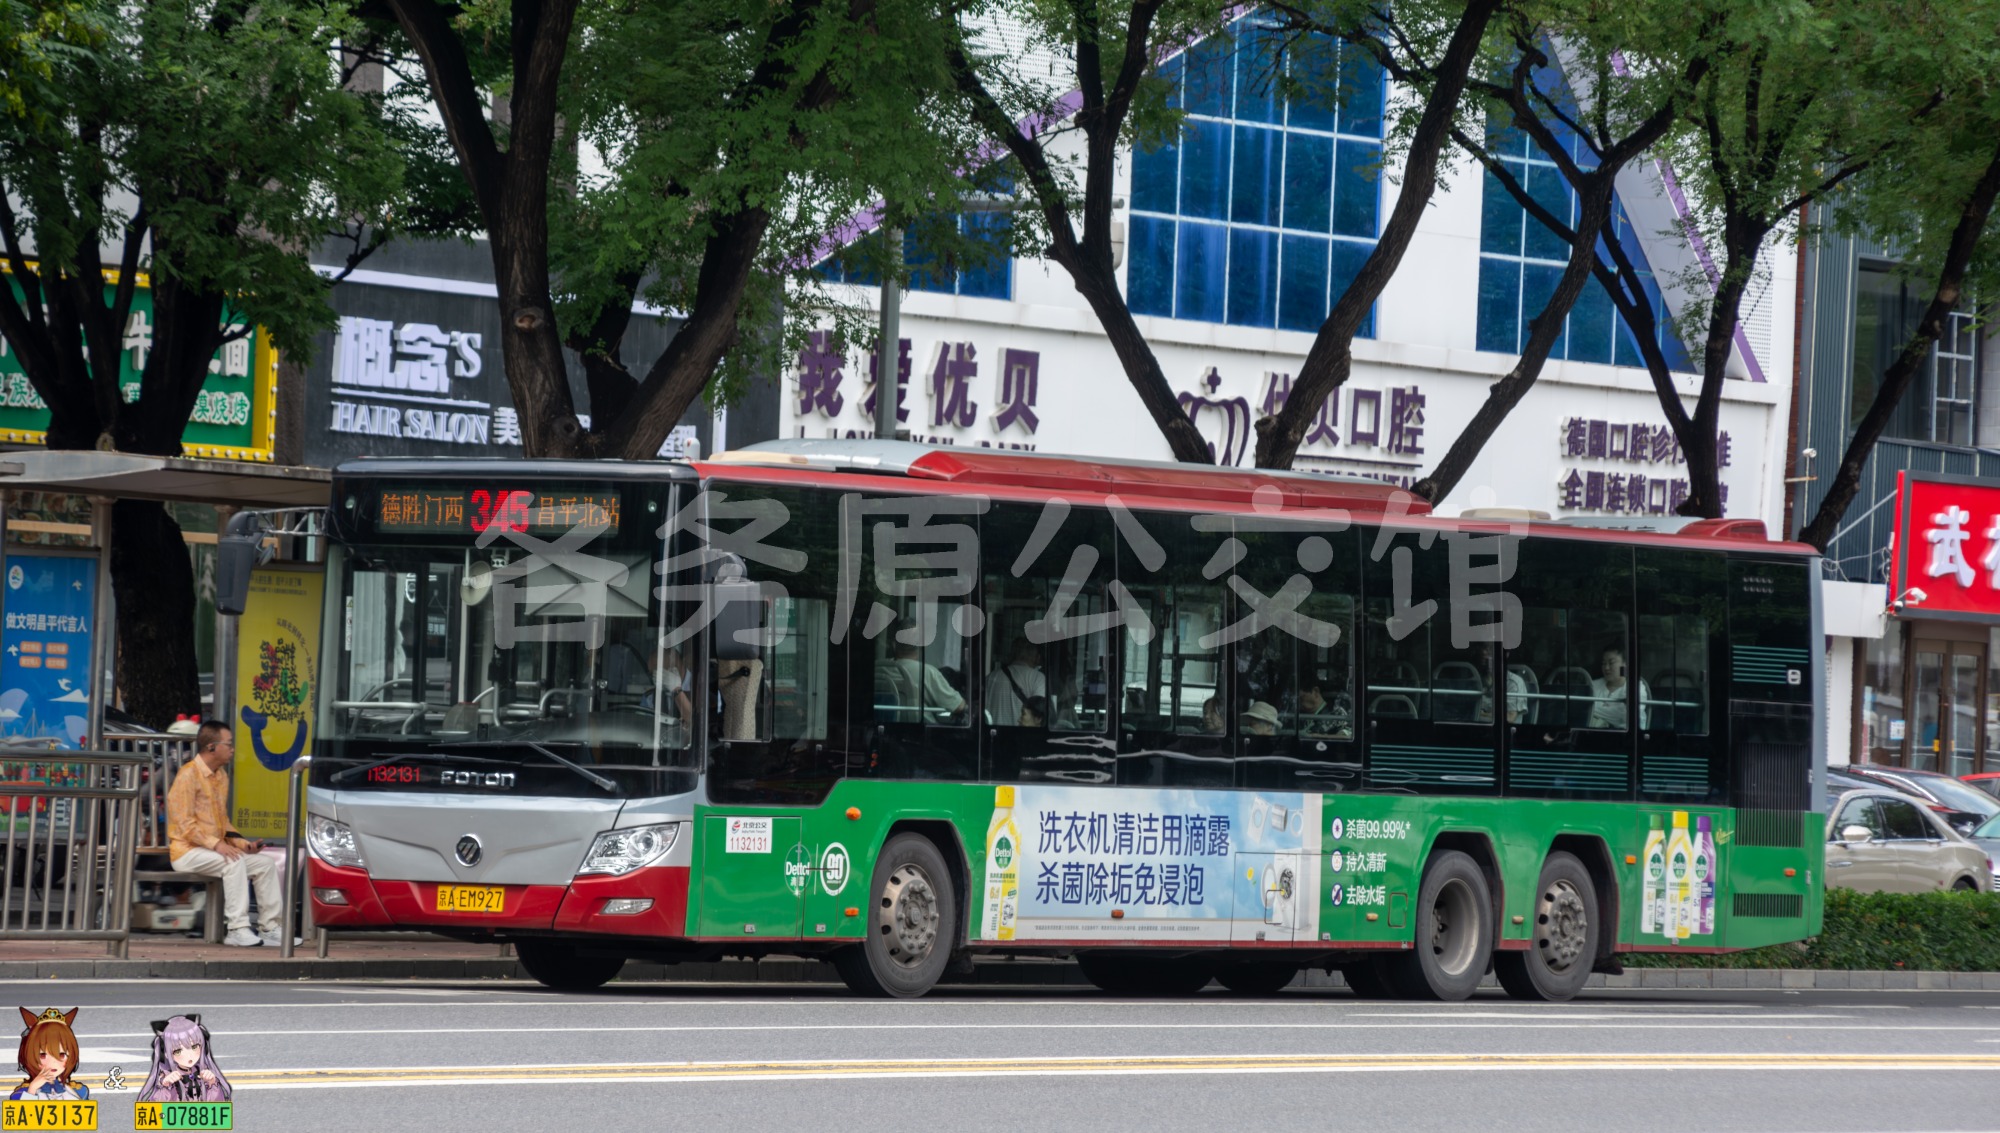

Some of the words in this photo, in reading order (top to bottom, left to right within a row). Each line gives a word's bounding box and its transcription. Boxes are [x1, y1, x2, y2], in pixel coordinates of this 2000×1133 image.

[330, 401, 401, 437] HAIR
[403, 406, 491, 445] SALON
[381, 493, 464, 526] 德胜门西
[470, 489, 530, 533] 345
[538, 496, 621, 528] 昌平北站
[6, 612, 88, 633] 做文明昌平代言人
[440, 770, 516, 788] FOTON
[730, 836, 767, 851] 1132131
[1038, 810, 1231, 858] 洗衣机清洁用滴露
[995, 847, 1013, 860] Dettol
[1346, 852, 1387, 873] 持久清新
[785, 861, 810, 876] Dettol
[1035, 861, 1204, 906] 杀菌除垢免浸泡
[1346, 885, 1387, 906] 去除水垢
